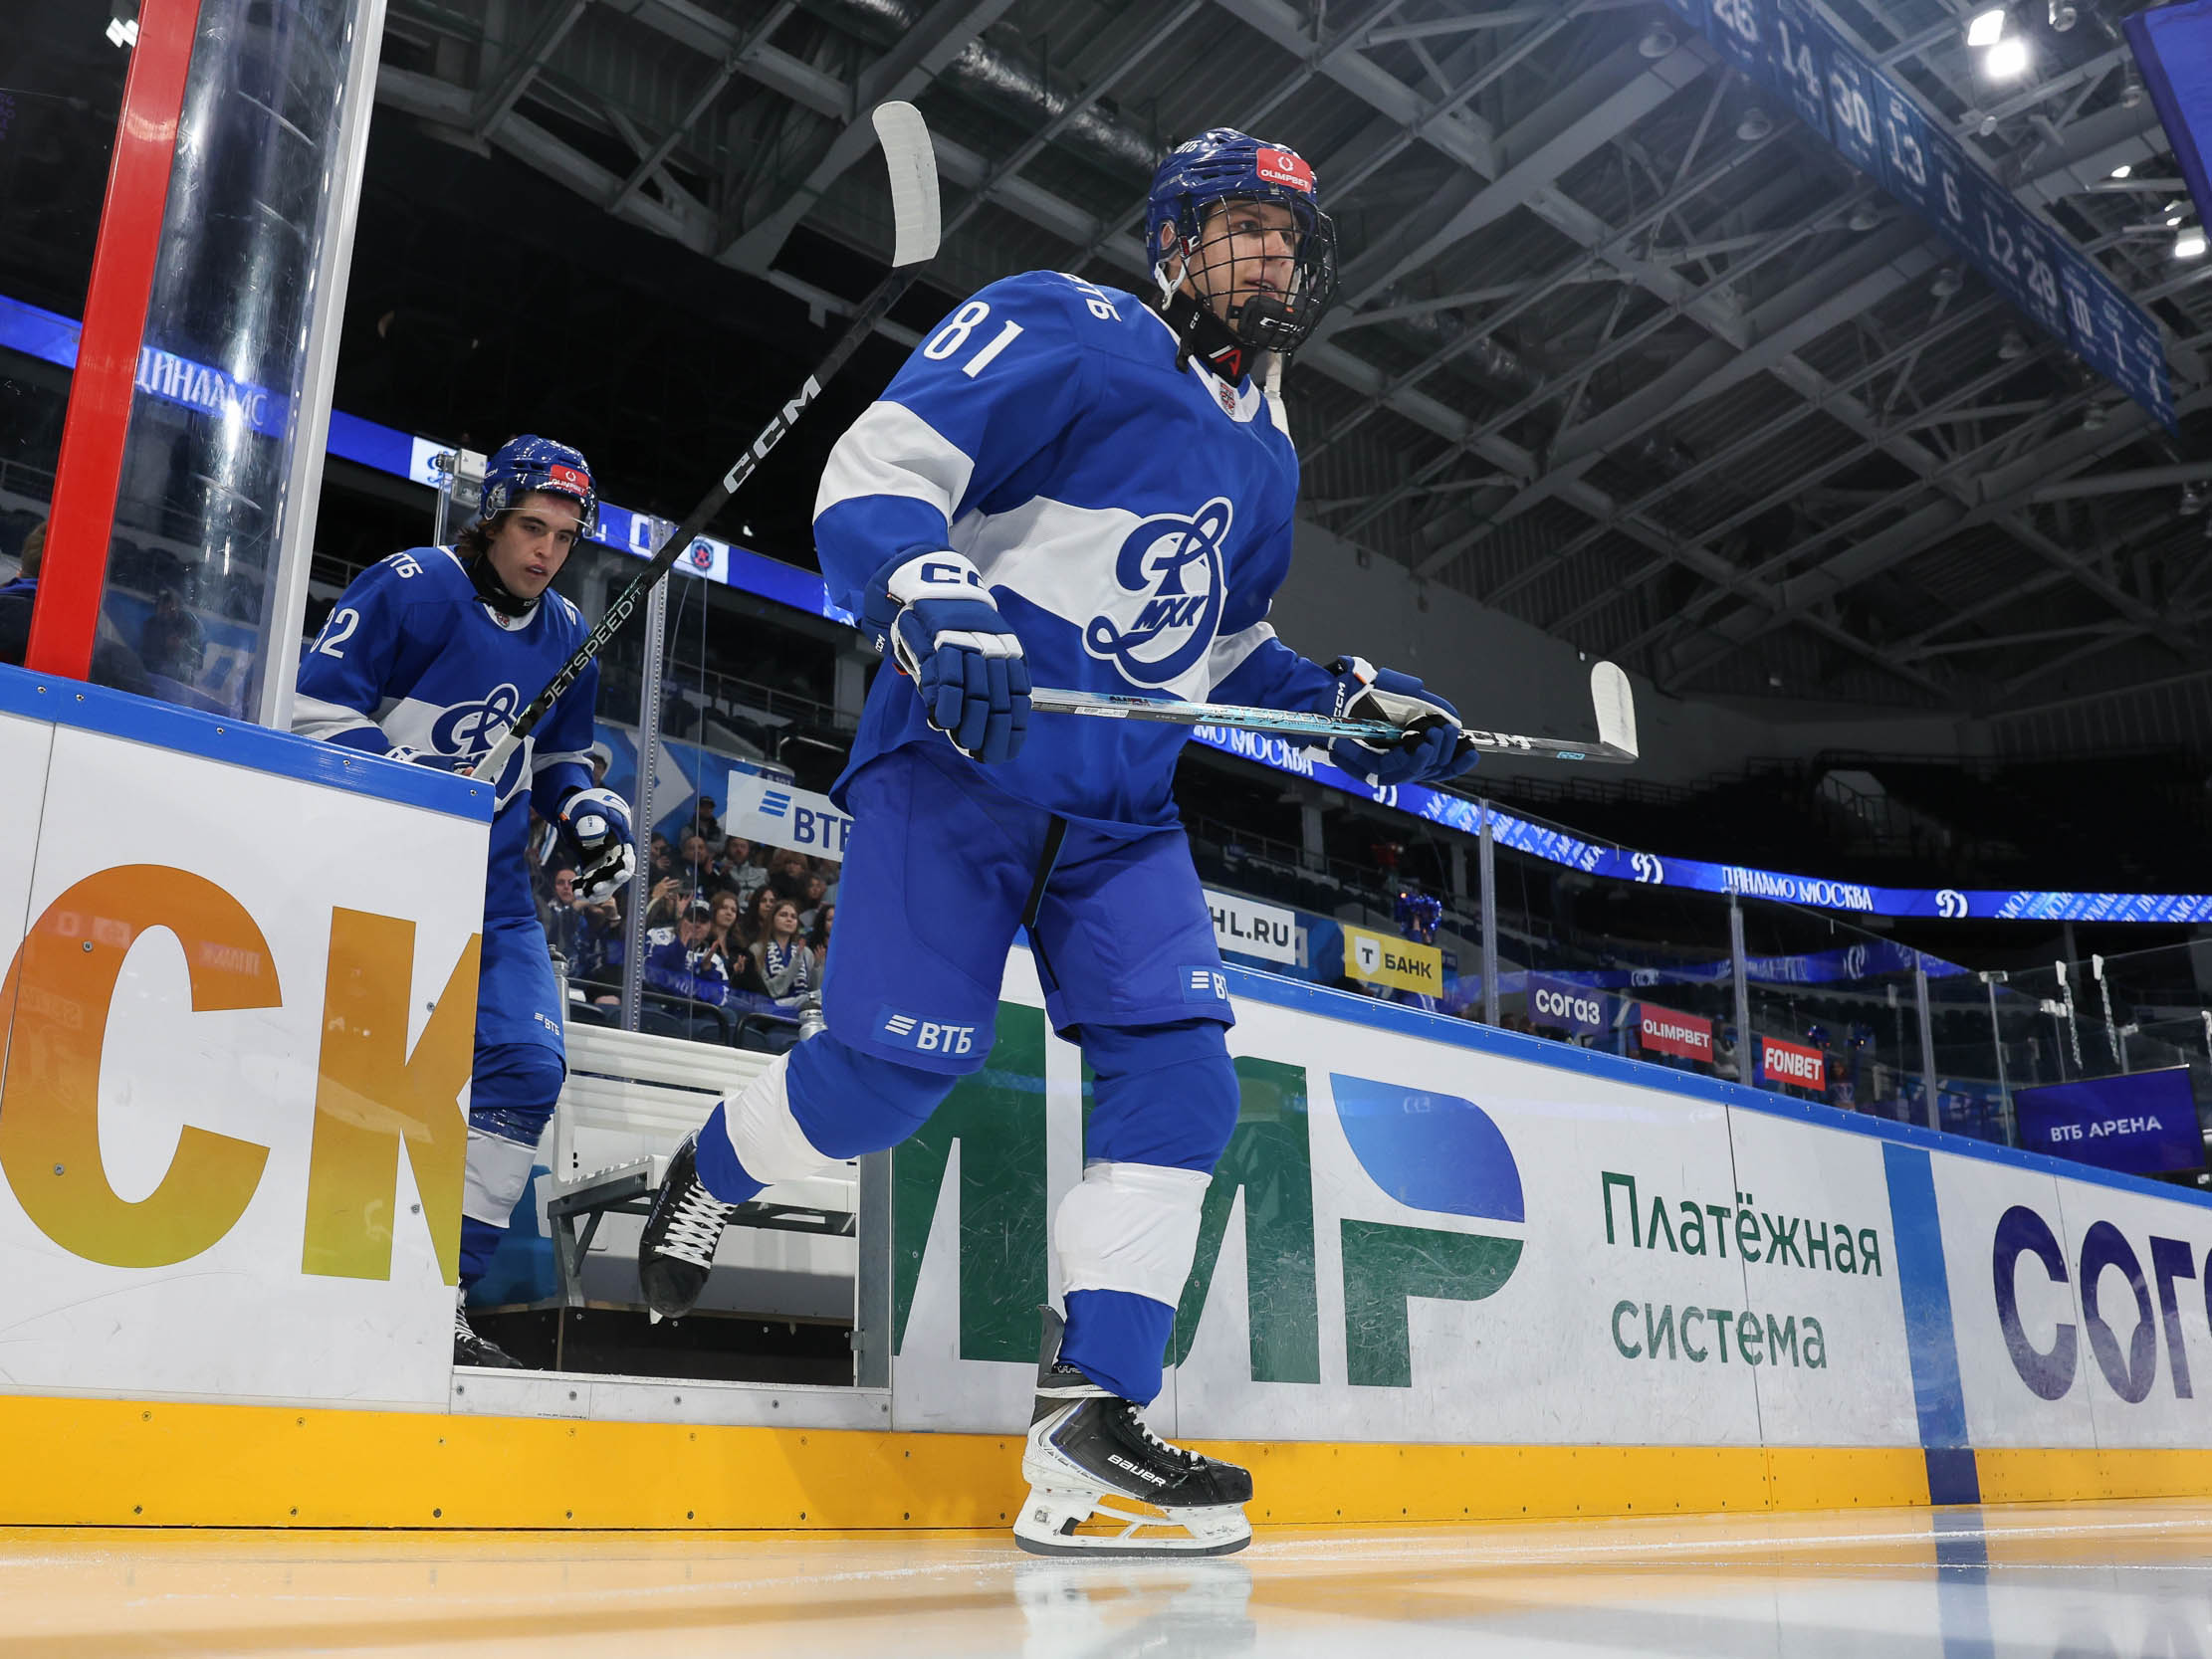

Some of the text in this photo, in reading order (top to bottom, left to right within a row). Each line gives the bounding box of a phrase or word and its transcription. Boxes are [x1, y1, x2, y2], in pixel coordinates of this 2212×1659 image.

[1259, 168, 1310, 188] OLIMPBET
[923, 301, 1024, 378] 81
[723, 374, 822, 494] CCM
[1720, 866, 1873, 912] ДИНАМО МОСКВА
[1209, 905, 1289, 946] HL.RU
[1385, 954, 1432, 979] БАНК
[545, 1018, 559, 1036] ВТБ
[916, 1022, 976, 1054] ВТБ
[1643, 1018, 1710, 1048] OLIMPBET
[1765, 1047, 1822, 1081] FONBET
[2051, 1115, 2163, 1142] ВТБ АРЕНА
[1601, 1170, 1882, 1277] Платёжная
[1612, 1300, 1828, 1369] система
[1107, 1454, 1166, 1488] BAUER
